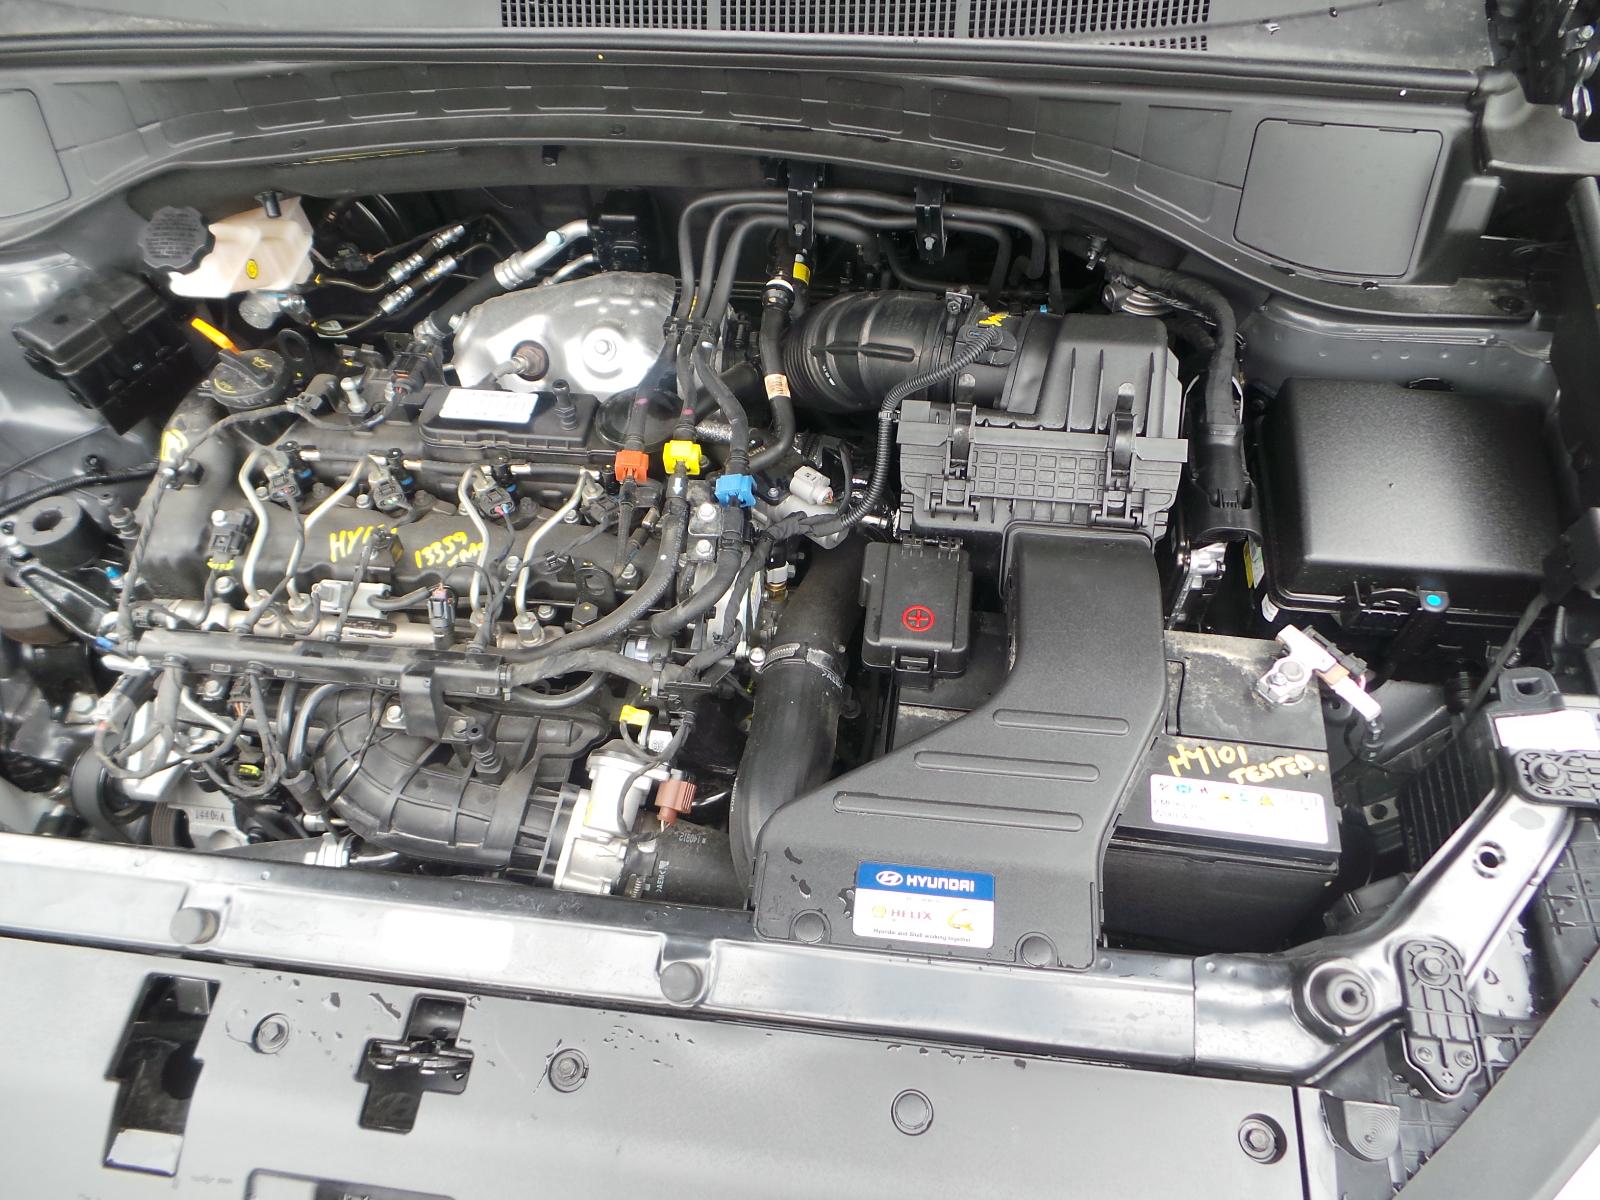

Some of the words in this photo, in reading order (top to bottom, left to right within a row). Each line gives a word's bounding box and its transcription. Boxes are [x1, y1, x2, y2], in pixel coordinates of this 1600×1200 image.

[906, 874, 975, 892] HYUNDAI
[890, 908, 932, 921] HELIX
[924, 933, 947, 942] working
